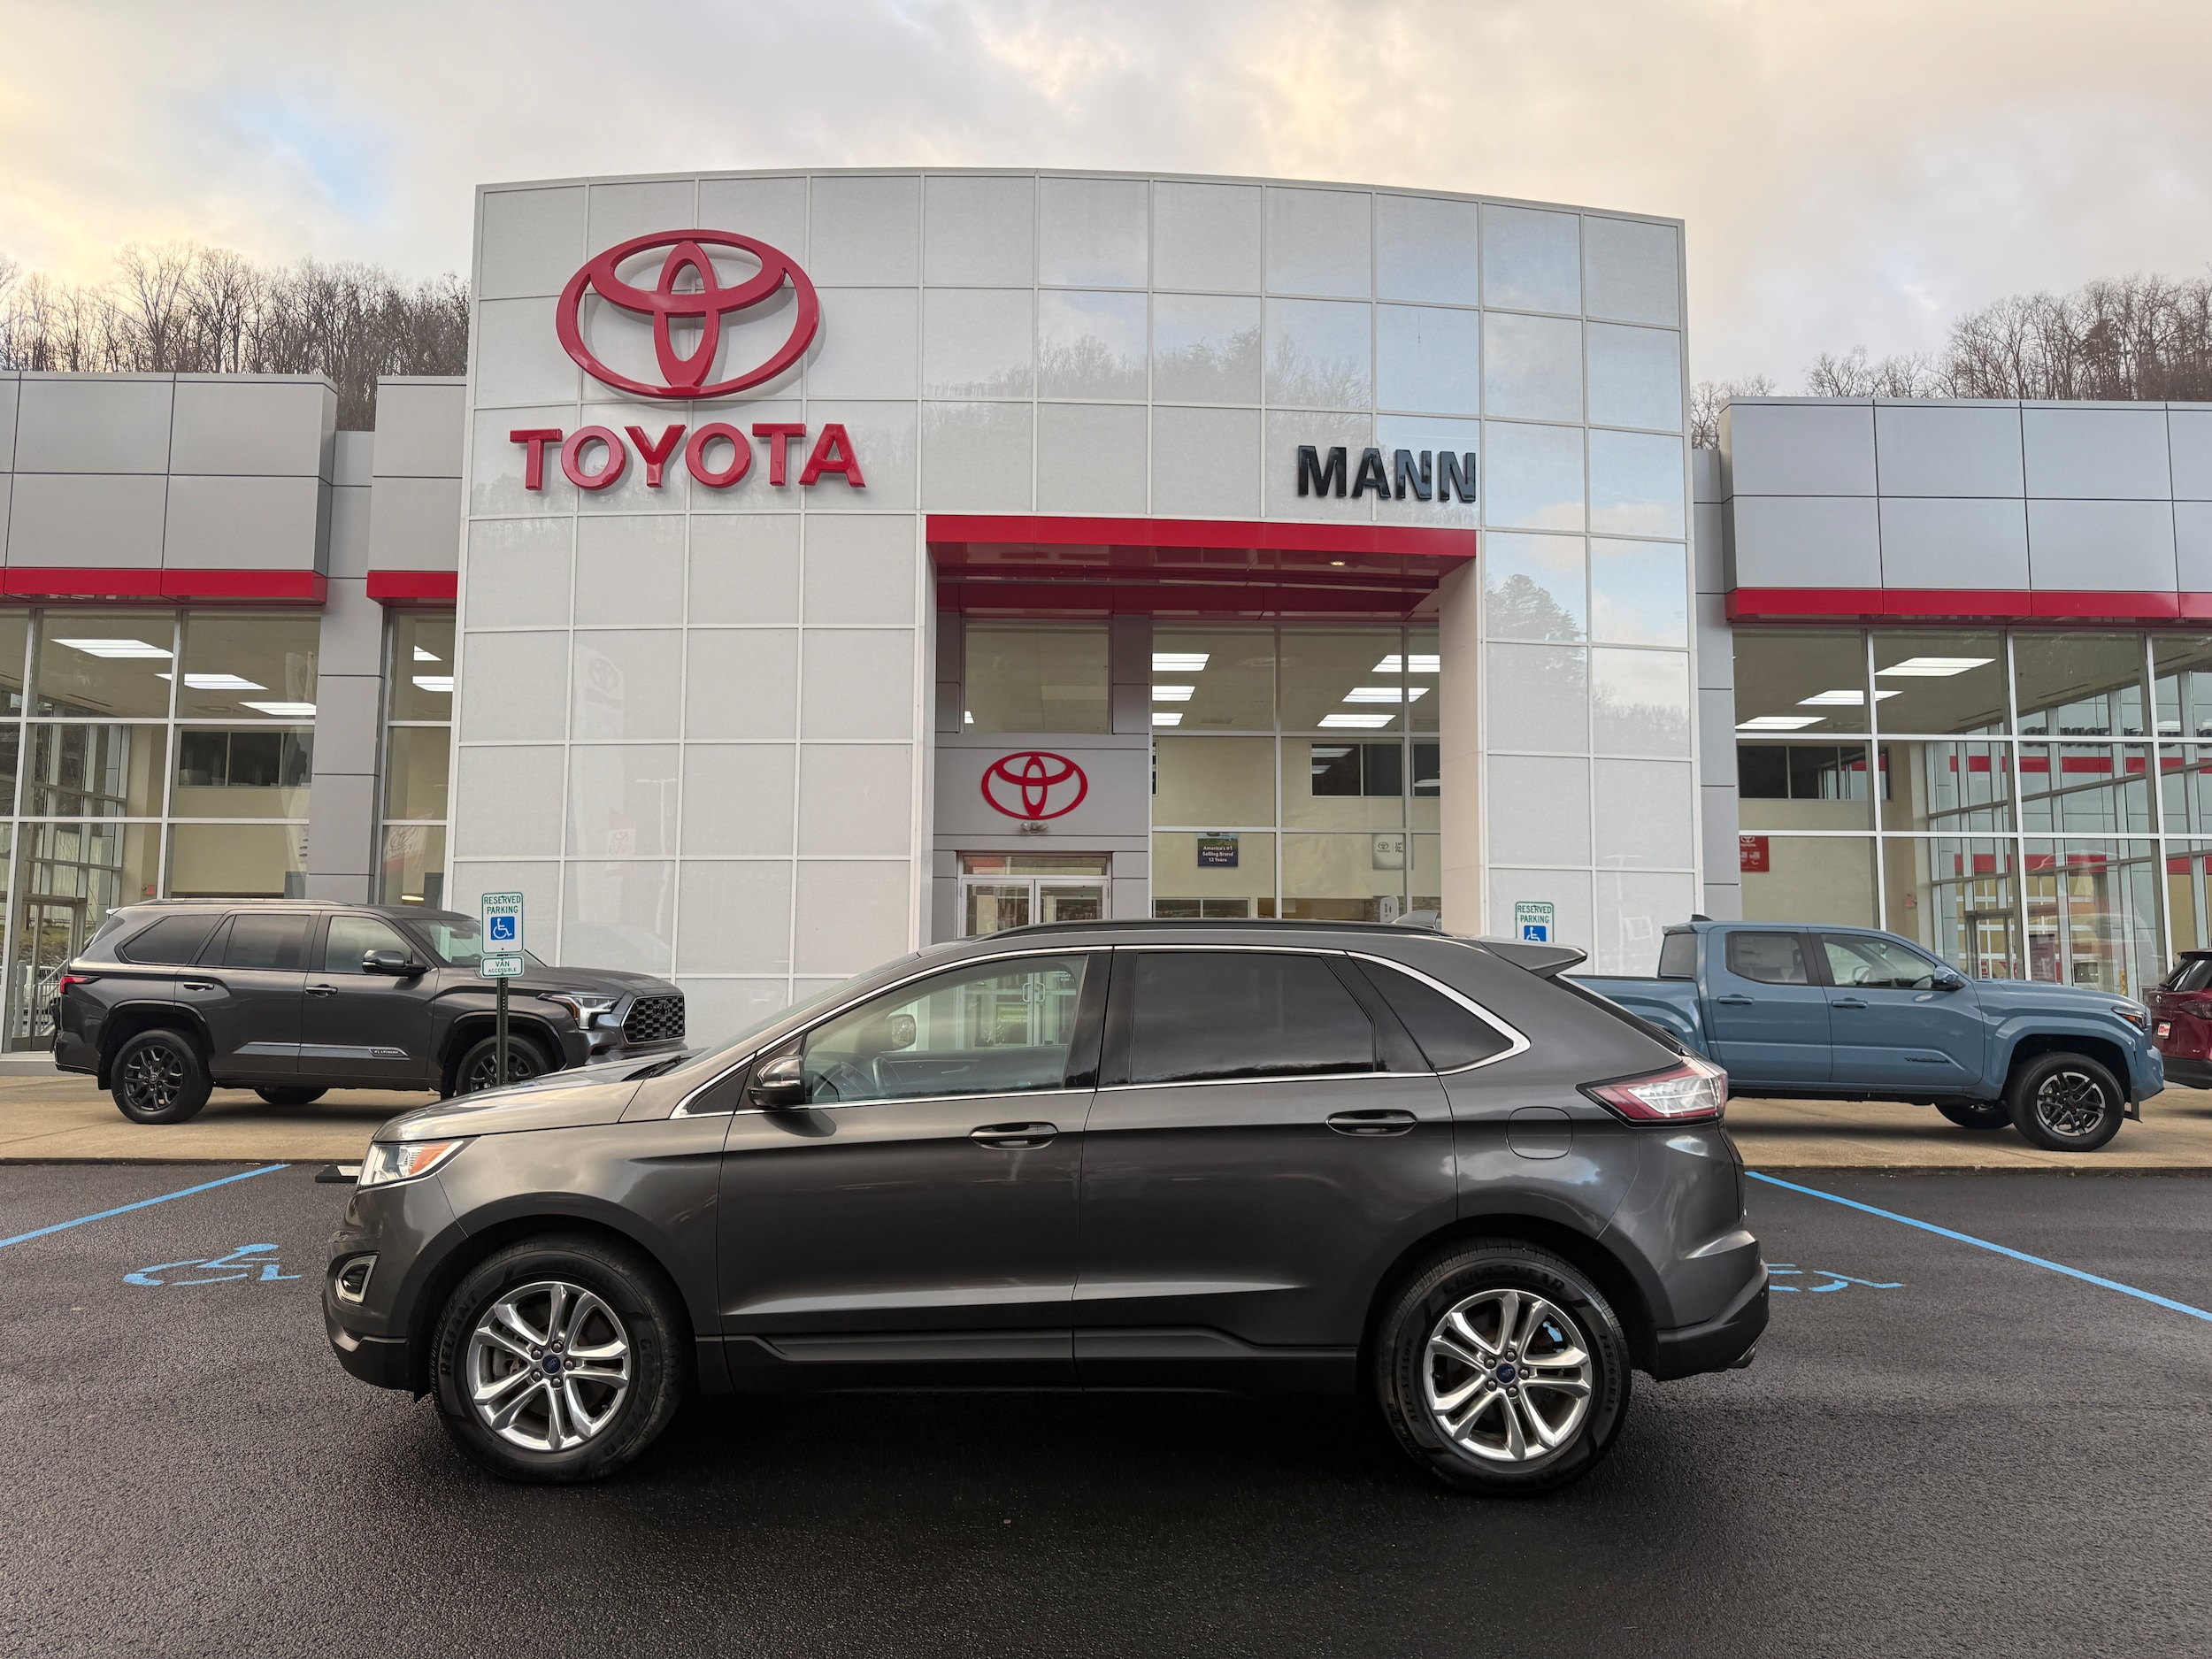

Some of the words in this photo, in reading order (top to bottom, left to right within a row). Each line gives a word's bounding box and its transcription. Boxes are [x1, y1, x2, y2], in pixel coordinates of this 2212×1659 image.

[510, 422, 866, 491] TOYOTA
[1297, 445, 1476, 502] MANN
[483, 895, 521, 905] RESERVED
[487, 906, 518, 915] PARKING
[1517, 904, 1552, 914] RESERVED
[1520, 914, 1549, 924] PARKING
